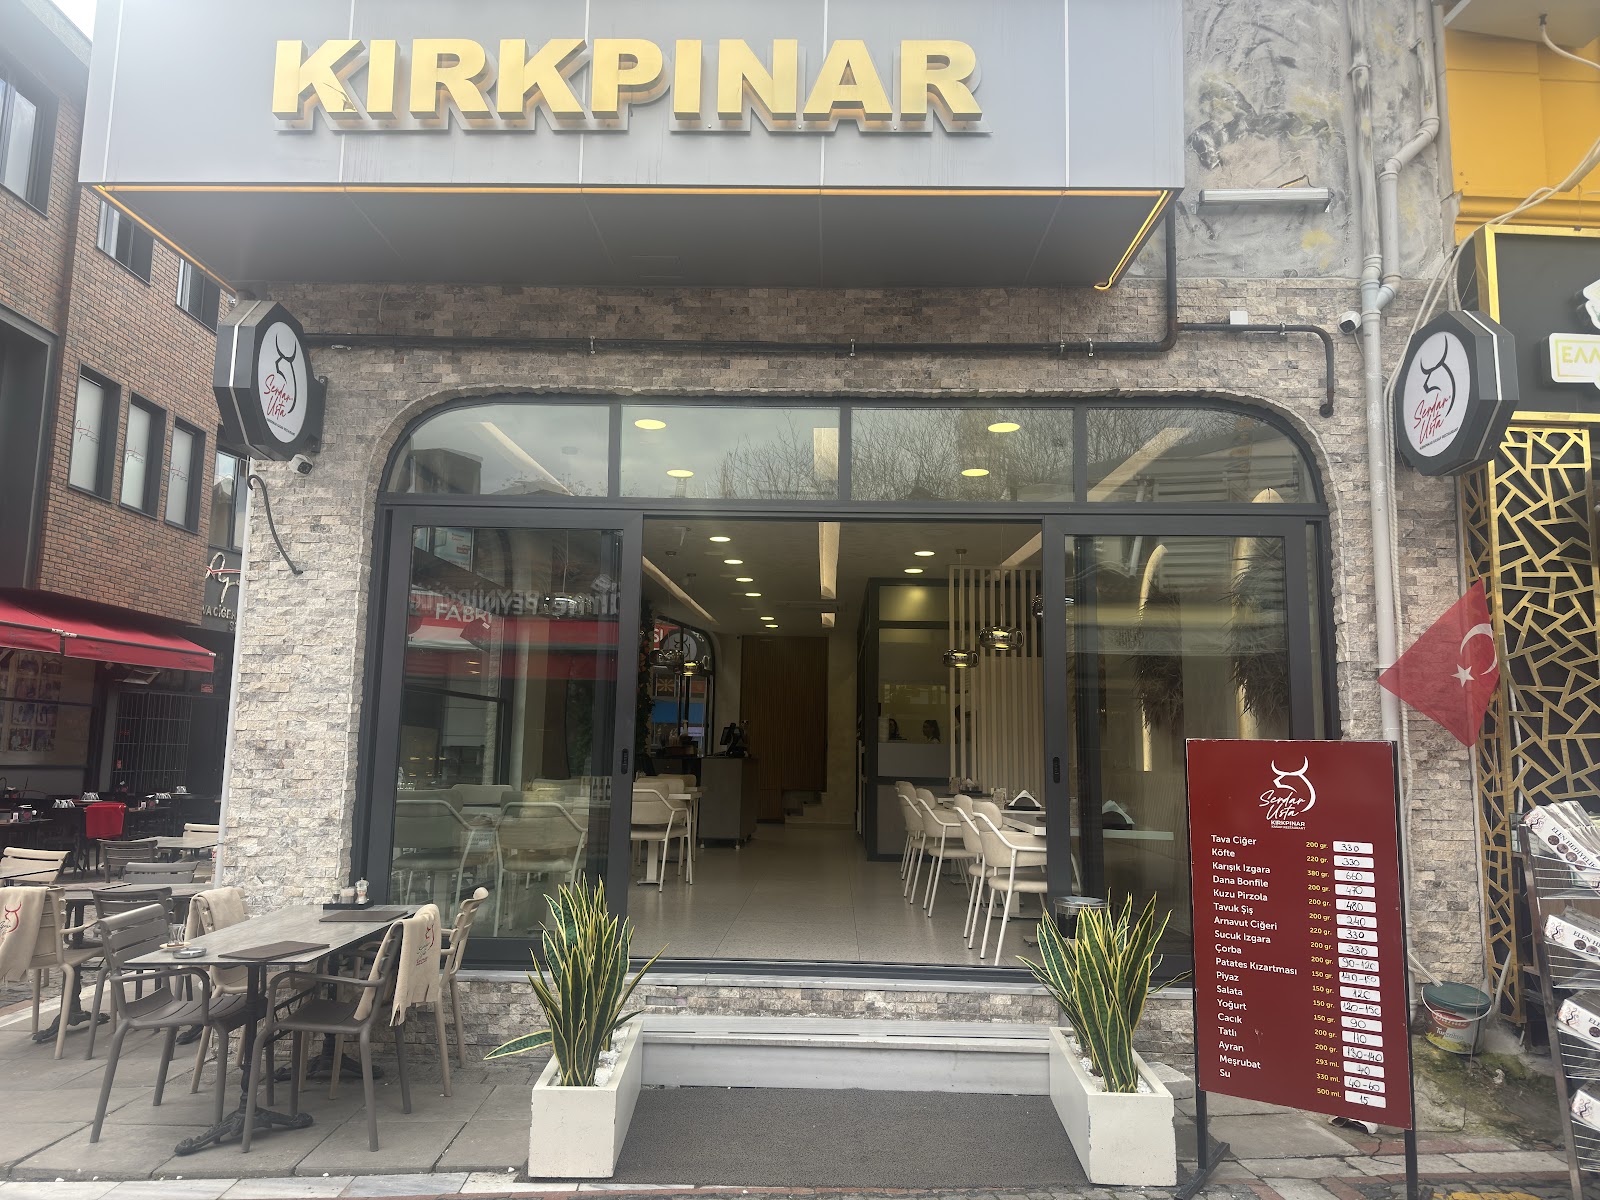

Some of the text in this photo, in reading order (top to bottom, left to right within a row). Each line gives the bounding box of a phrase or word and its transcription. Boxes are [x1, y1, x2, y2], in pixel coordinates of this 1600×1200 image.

[271, 38, 984, 124] KIRKPINAR
[266, 395, 287, 421] Usta
[1413, 393, 1449, 430] Serdar
[1419, 411, 1445, 445] Usta
[1258, 789, 1306, 807] Serdar
[1266, 803, 1299, 820] Usta
[1211, 834, 1230, 844] Tava
[1232, 836, 1256, 846] Ciğer
[1212, 848, 1236, 857] Köfte
[1212, 862, 1241, 872] Karışık
[1243, 864, 1270, 874] Izgara
[1212, 875, 1235, 884] Dana
[1237, 877, 1268, 888] Bonfile
[1213, 889, 1235, 898] Kuzu
[1237, 891, 1268, 901] Pirzola
[1213, 902, 1239, 912] Tavuk
[1241, 905, 1253, 915] Şiş
[1214, 916, 1248, 927] Arnavut
[1250, 920, 1278, 931] Ciğeri
[1346, 916, 1365, 927] 240
[1214, 930, 1242, 940] Sucuk
[1244, 933, 1271, 943] Izgara
[1573, 930, 1591, 943] ELEN
[1215, 944, 1242, 954] Çorba
[1347, 945, 1368, 956] 330
[1216, 957, 1248, 968] Patates
[1250, 962, 1297, 975] Kızartması
[1216, 971, 1239, 981] Piyaz
[1216, 985, 1243, 996] Salata
[1217, 999, 1247, 1010] Yoğurt
[1314, 1014, 1326, 1022] 150
[1217, 1013, 1242, 1024] Cacık
[1350, 1018, 1366, 1028] 90
[1218, 1026, 1237, 1037] Tatlı
[1218, 1040, 1244, 1052] Ayran
[1219, 1054, 1261, 1069] Meşrubat
[1220, 1068, 1231, 1078] Su
[1360, 1095, 1370, 1105] 15
